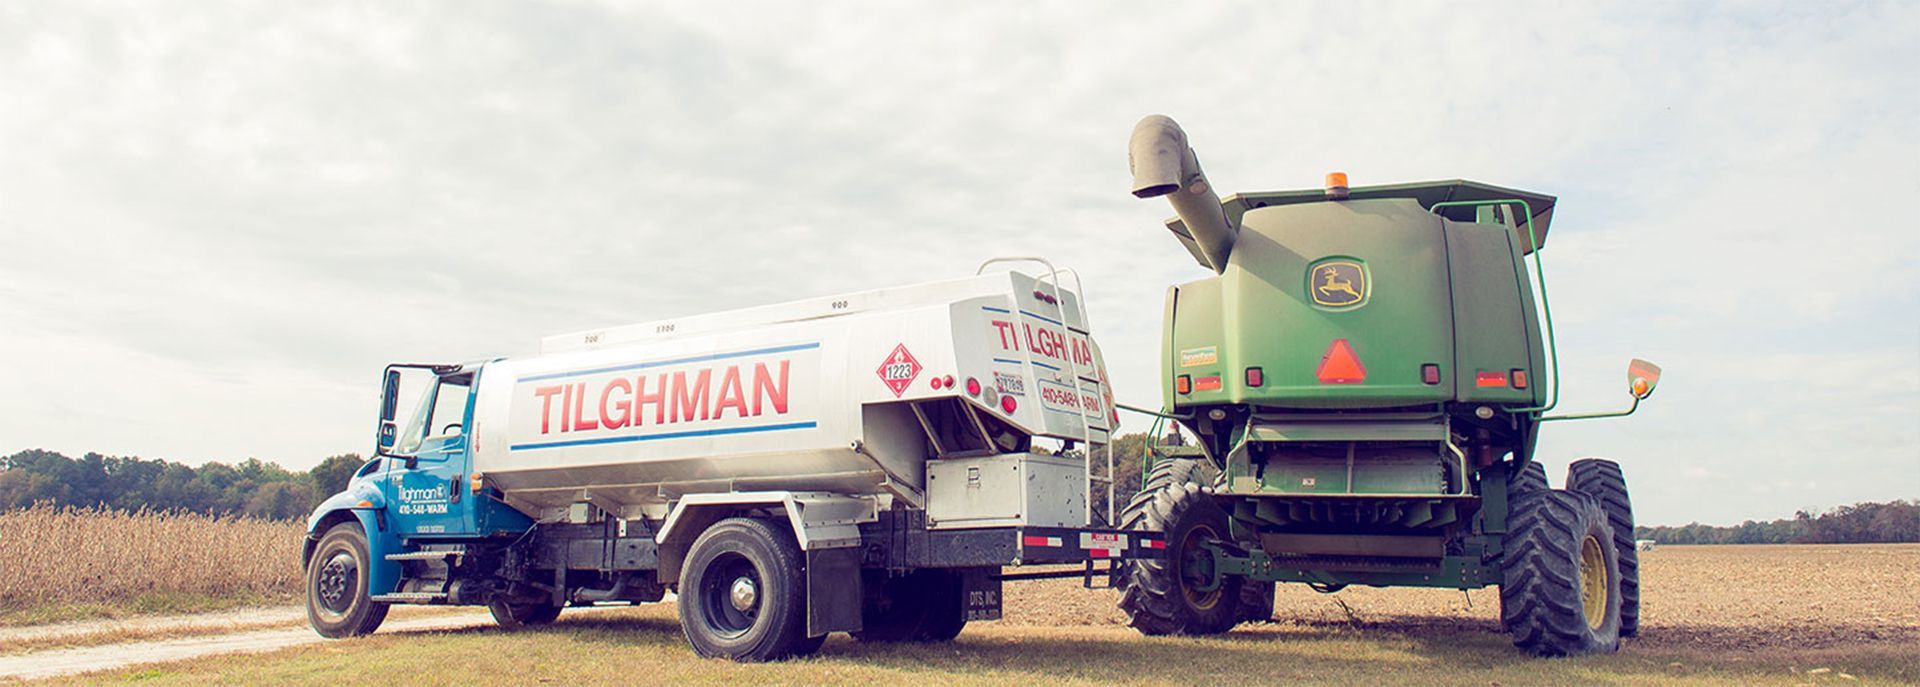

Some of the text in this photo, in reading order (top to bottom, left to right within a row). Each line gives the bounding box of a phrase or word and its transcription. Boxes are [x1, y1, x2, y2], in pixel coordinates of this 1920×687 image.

[887, 363, 912, 379] 1223
[895, 381, 902, 390] 3
[535, 359, 790, 434] TILGHMAN
[398, 485, 437, 503] Tilghman
[399, 503, 447, 514] 410-548-WARM
